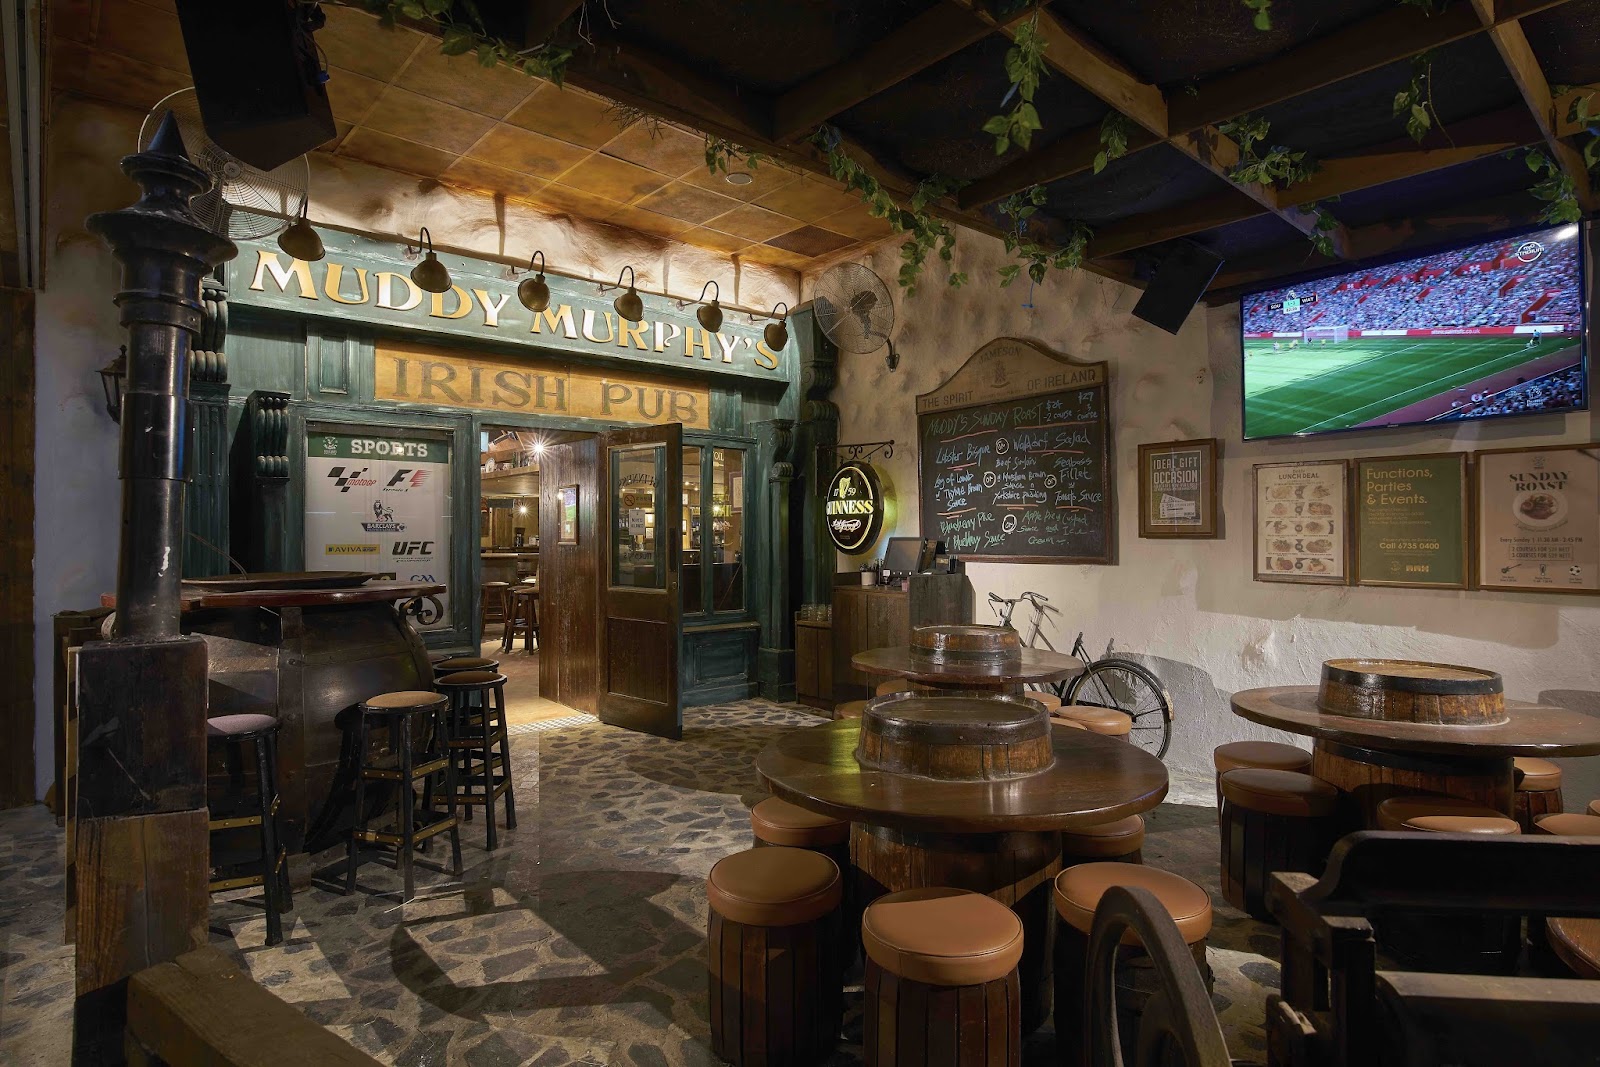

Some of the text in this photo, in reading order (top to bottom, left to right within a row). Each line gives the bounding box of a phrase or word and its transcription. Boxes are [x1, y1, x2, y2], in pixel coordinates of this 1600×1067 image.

[1514, 247, 1545, 257] STADIUM
[249, 250, 780, 370] MUDDY MURPHY'S
[978, 345, 1021, 366] JAMESON
[392, 356, 700, 424] IRISH PUB
[922, 398, 940, 408] THE
[943, 390, 974, 405] SPIRIT
[1027, 378, 1041, 391] OF
[1044, 368, 1096, 388] IRELAND
[351, 439, 428, 457] SPORTS
[1153, 458, 1177, 470] IDEAL
[1179, 456, 1198, 468] GIFT
[1153, 470, 1198, 484] OCCASION
[1366, 468, 1433, 479] Functions,
[1509, 471, 1568, 482] SUNDAY
[847, 487, 857, 497] 59
[1366, 481, 1412, 492] Parties
[1515, 481, 1566, 491] ROAST
[1366, 493, 1429, 505] & Events.
[825, 499, 875, 515] GUINNESS
[391, 541, 435, 555] UFC
[1419, 542, 1440, 550] 0400
